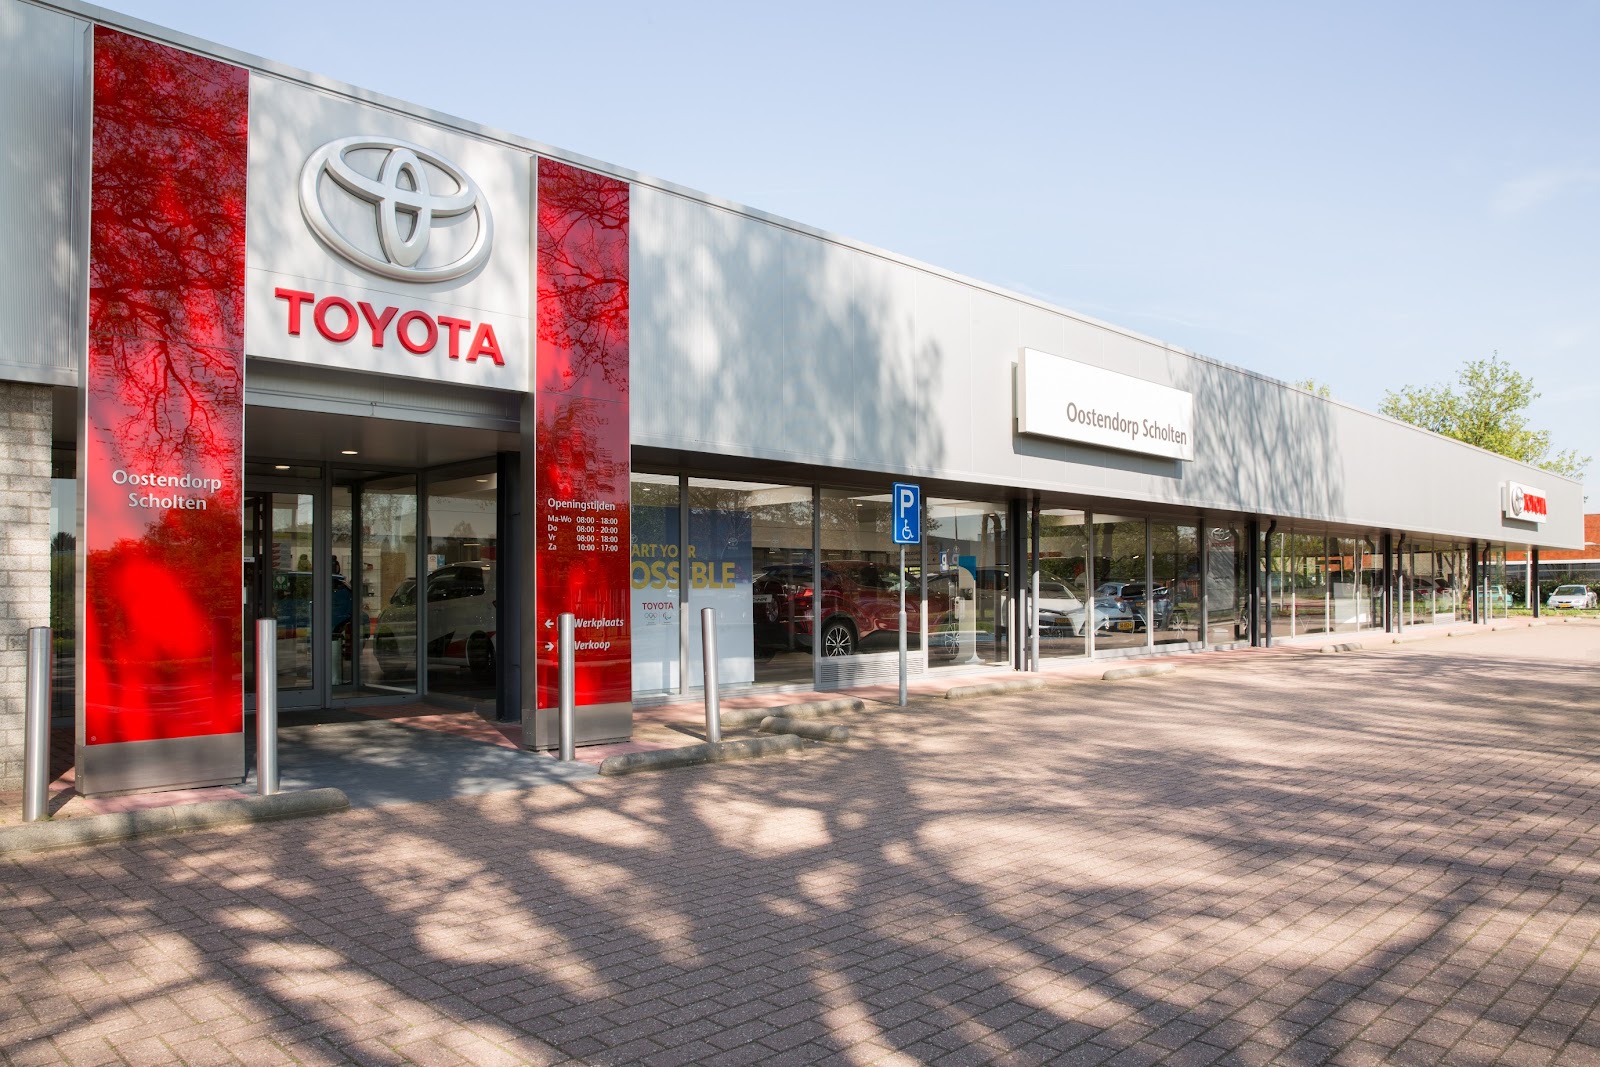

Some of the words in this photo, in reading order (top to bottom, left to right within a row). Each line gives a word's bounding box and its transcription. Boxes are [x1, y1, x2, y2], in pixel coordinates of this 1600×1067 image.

[274, 287, 506, 366] TOYOTA
[1066, 402, 1139, 441] Oostendorp
[1143, 418, 1187, 445] Scholten
[112, 469, 222, 494] Oostendorp
[128, 492, 207, 511] Scholten
[547, 498, 616, 512] Openingstijden
[900, 489, 915, 518] P
[547, 514, 572, 523] Ma-Wo
[576, 516, 595, 524] 08:00
[600, 517, 618, 525] 18:00
[547, 524, 558, 532] Do
[576, 525, 595, 533] 08:00
[600, 526, 618, 534] 20:00
[548, 533, 557, 541] Vr
[576, 534, 595, 542] 08:00
[600, 535, 618, 543] 18:00
[547, 543, 557, 551] Za
[577, 543, 595, 552] 10:00
[660, 544, 696, 559] YOR
[630, 560, 736, 590] OSSBLE
[642, 602, 674, 610] TOYOTA
[574, 618, 624, 629] Werkplaats
[574, 640, 611, 651] Verkoop
